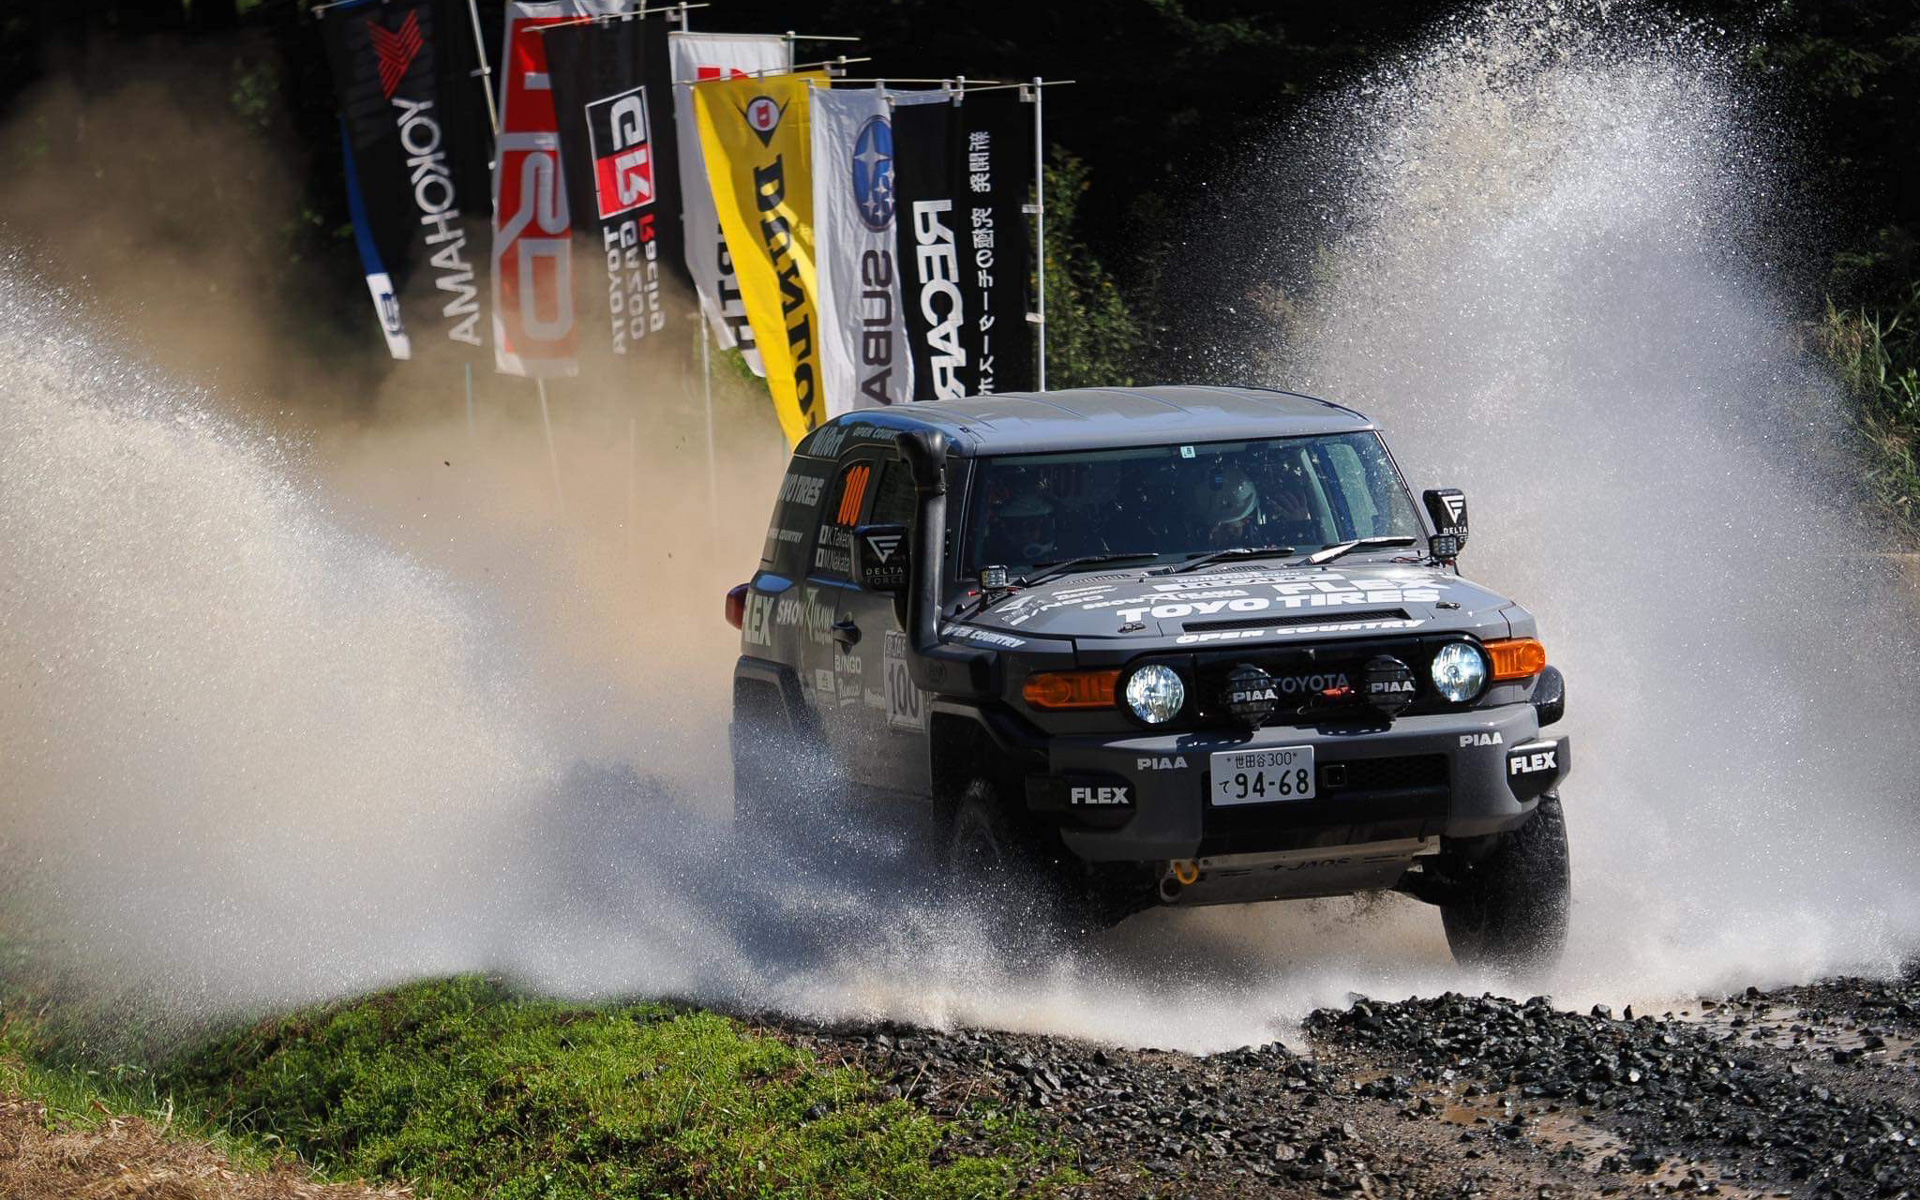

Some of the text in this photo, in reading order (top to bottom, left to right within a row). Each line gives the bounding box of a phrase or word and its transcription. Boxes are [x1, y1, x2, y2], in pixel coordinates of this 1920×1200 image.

[837, 466, 870, 526] 100
[1442, 525, 1468, 535] DELTA
[865, 566, 904, 576] DELTA
[1116, 589, 1441, 624] TOYO TIRES
[972, 629, 1027, 649] COUNTRY
[1176, 619, 1427, 645] OPEN COUNTRY
[834, 655, 861, 674] BINGO
[1232, 688, 1277, 703] PIAA
[1371, 681, 1416, 695] PIAA
[1460, 731, 1504, 747] PIAA
[1137, 756, 1189, 770] PIAA
[1510, 751, 1557, 775] FLEX
[1235, 769, 1310, 800] 94-68
[1071, 788, 1130, 805] FLEX
